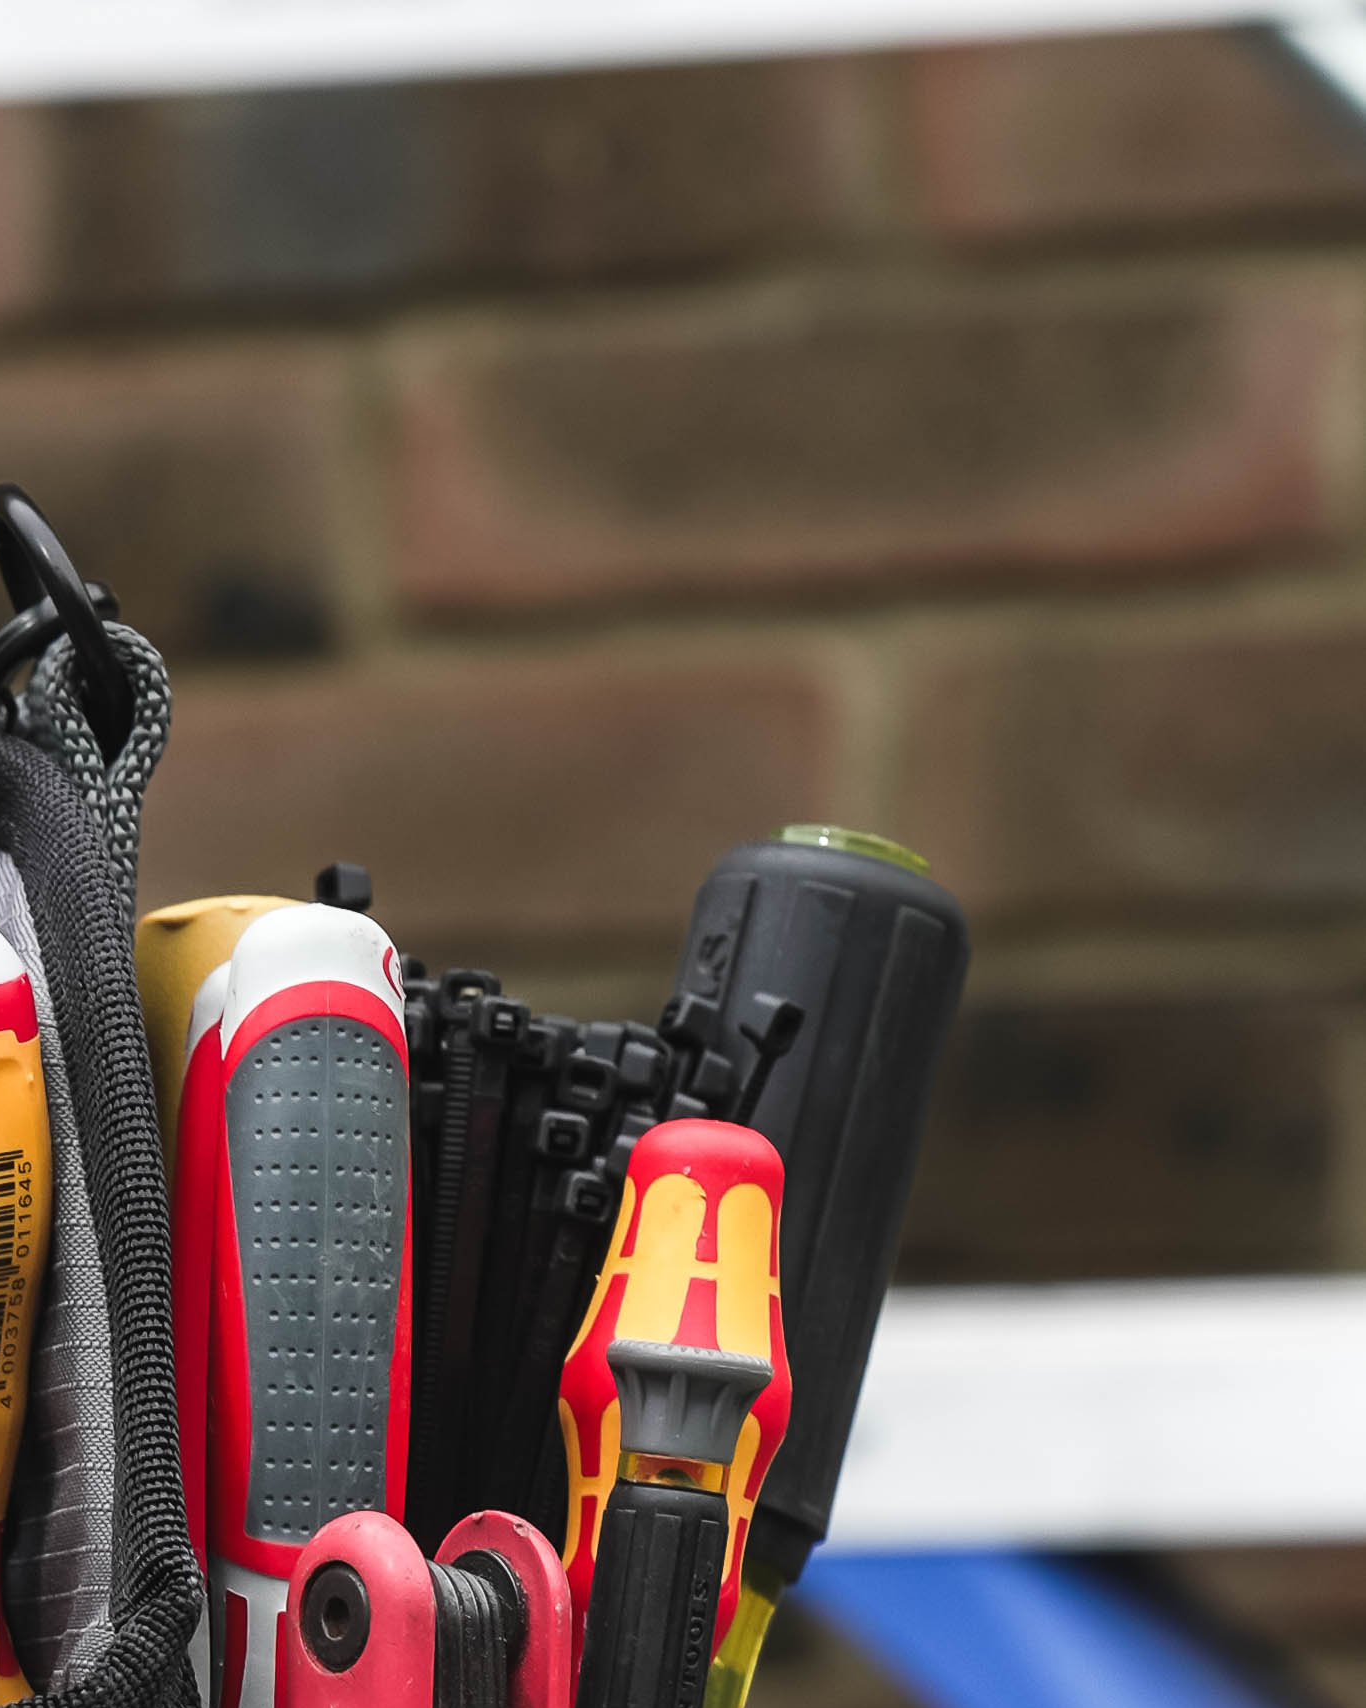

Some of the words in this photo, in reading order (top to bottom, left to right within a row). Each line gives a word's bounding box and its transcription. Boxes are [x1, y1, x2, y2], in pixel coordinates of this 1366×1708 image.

[17, 1161, 33, 1259] 011645
[2, 1277, 26, 1374] 003758
[0, 1395, 11, 1409] 4
[681, 1573, 709, 1690] TOOLS
